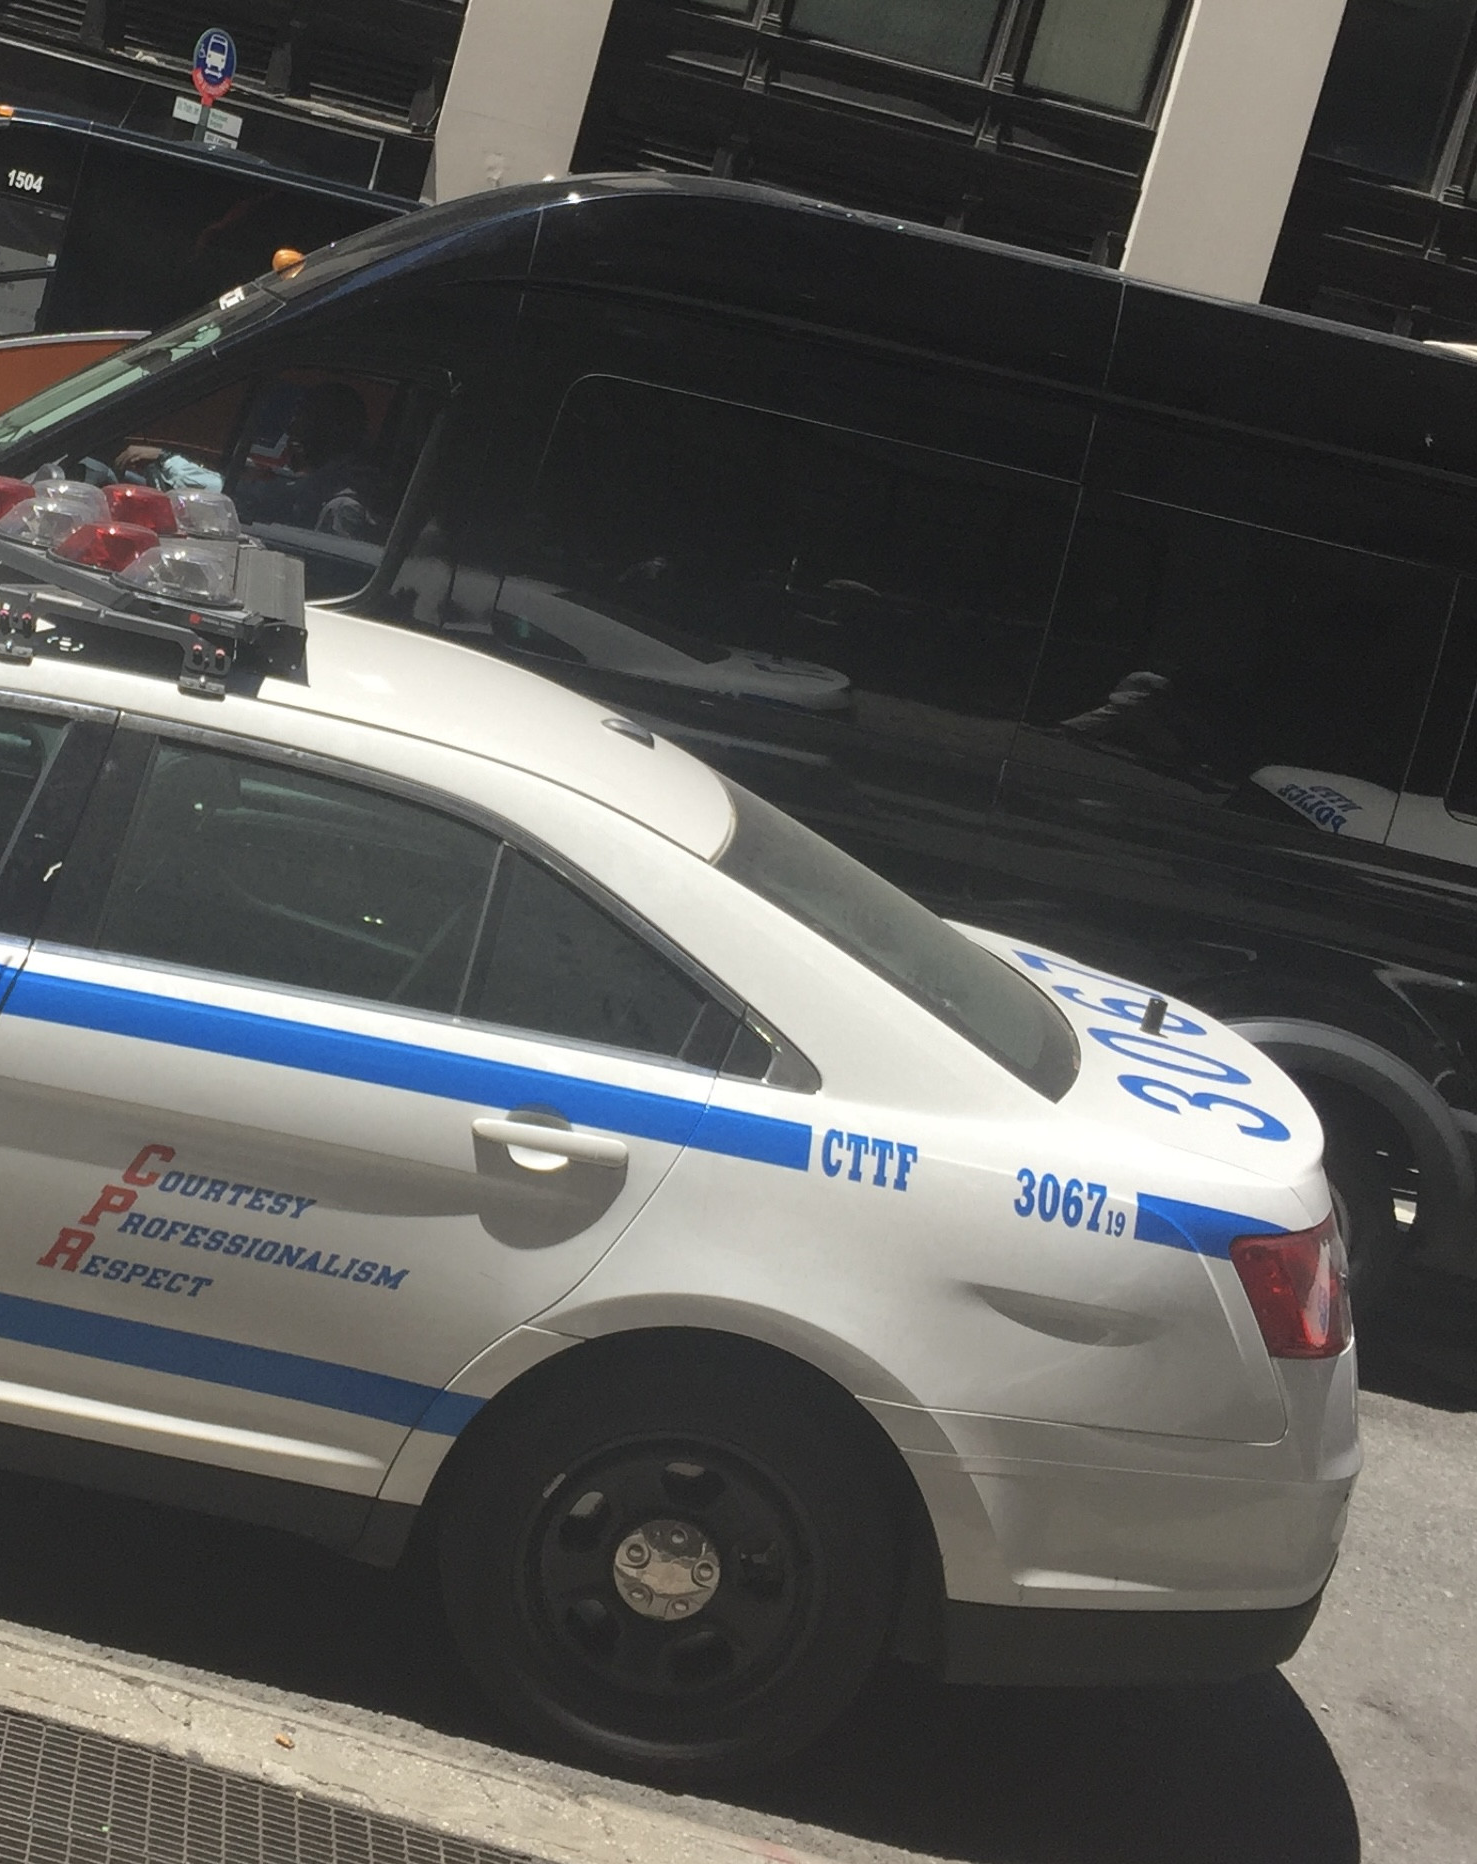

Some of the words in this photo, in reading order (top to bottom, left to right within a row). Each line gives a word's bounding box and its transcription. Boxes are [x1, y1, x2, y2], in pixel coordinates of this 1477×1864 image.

[8, 169, 44, 193] 1504
[121, 1143, 317, 1220] COURTESY
[821, 1128, 918, 1192] CTTF
[78, 1184, 410, 1291] PROFESSIONALISM
[1014, 1167, 1108, 1233] 3067
[1105, 1210, 1126, 1238] 19
[36, 1227, 214, 1298] RESPECT
